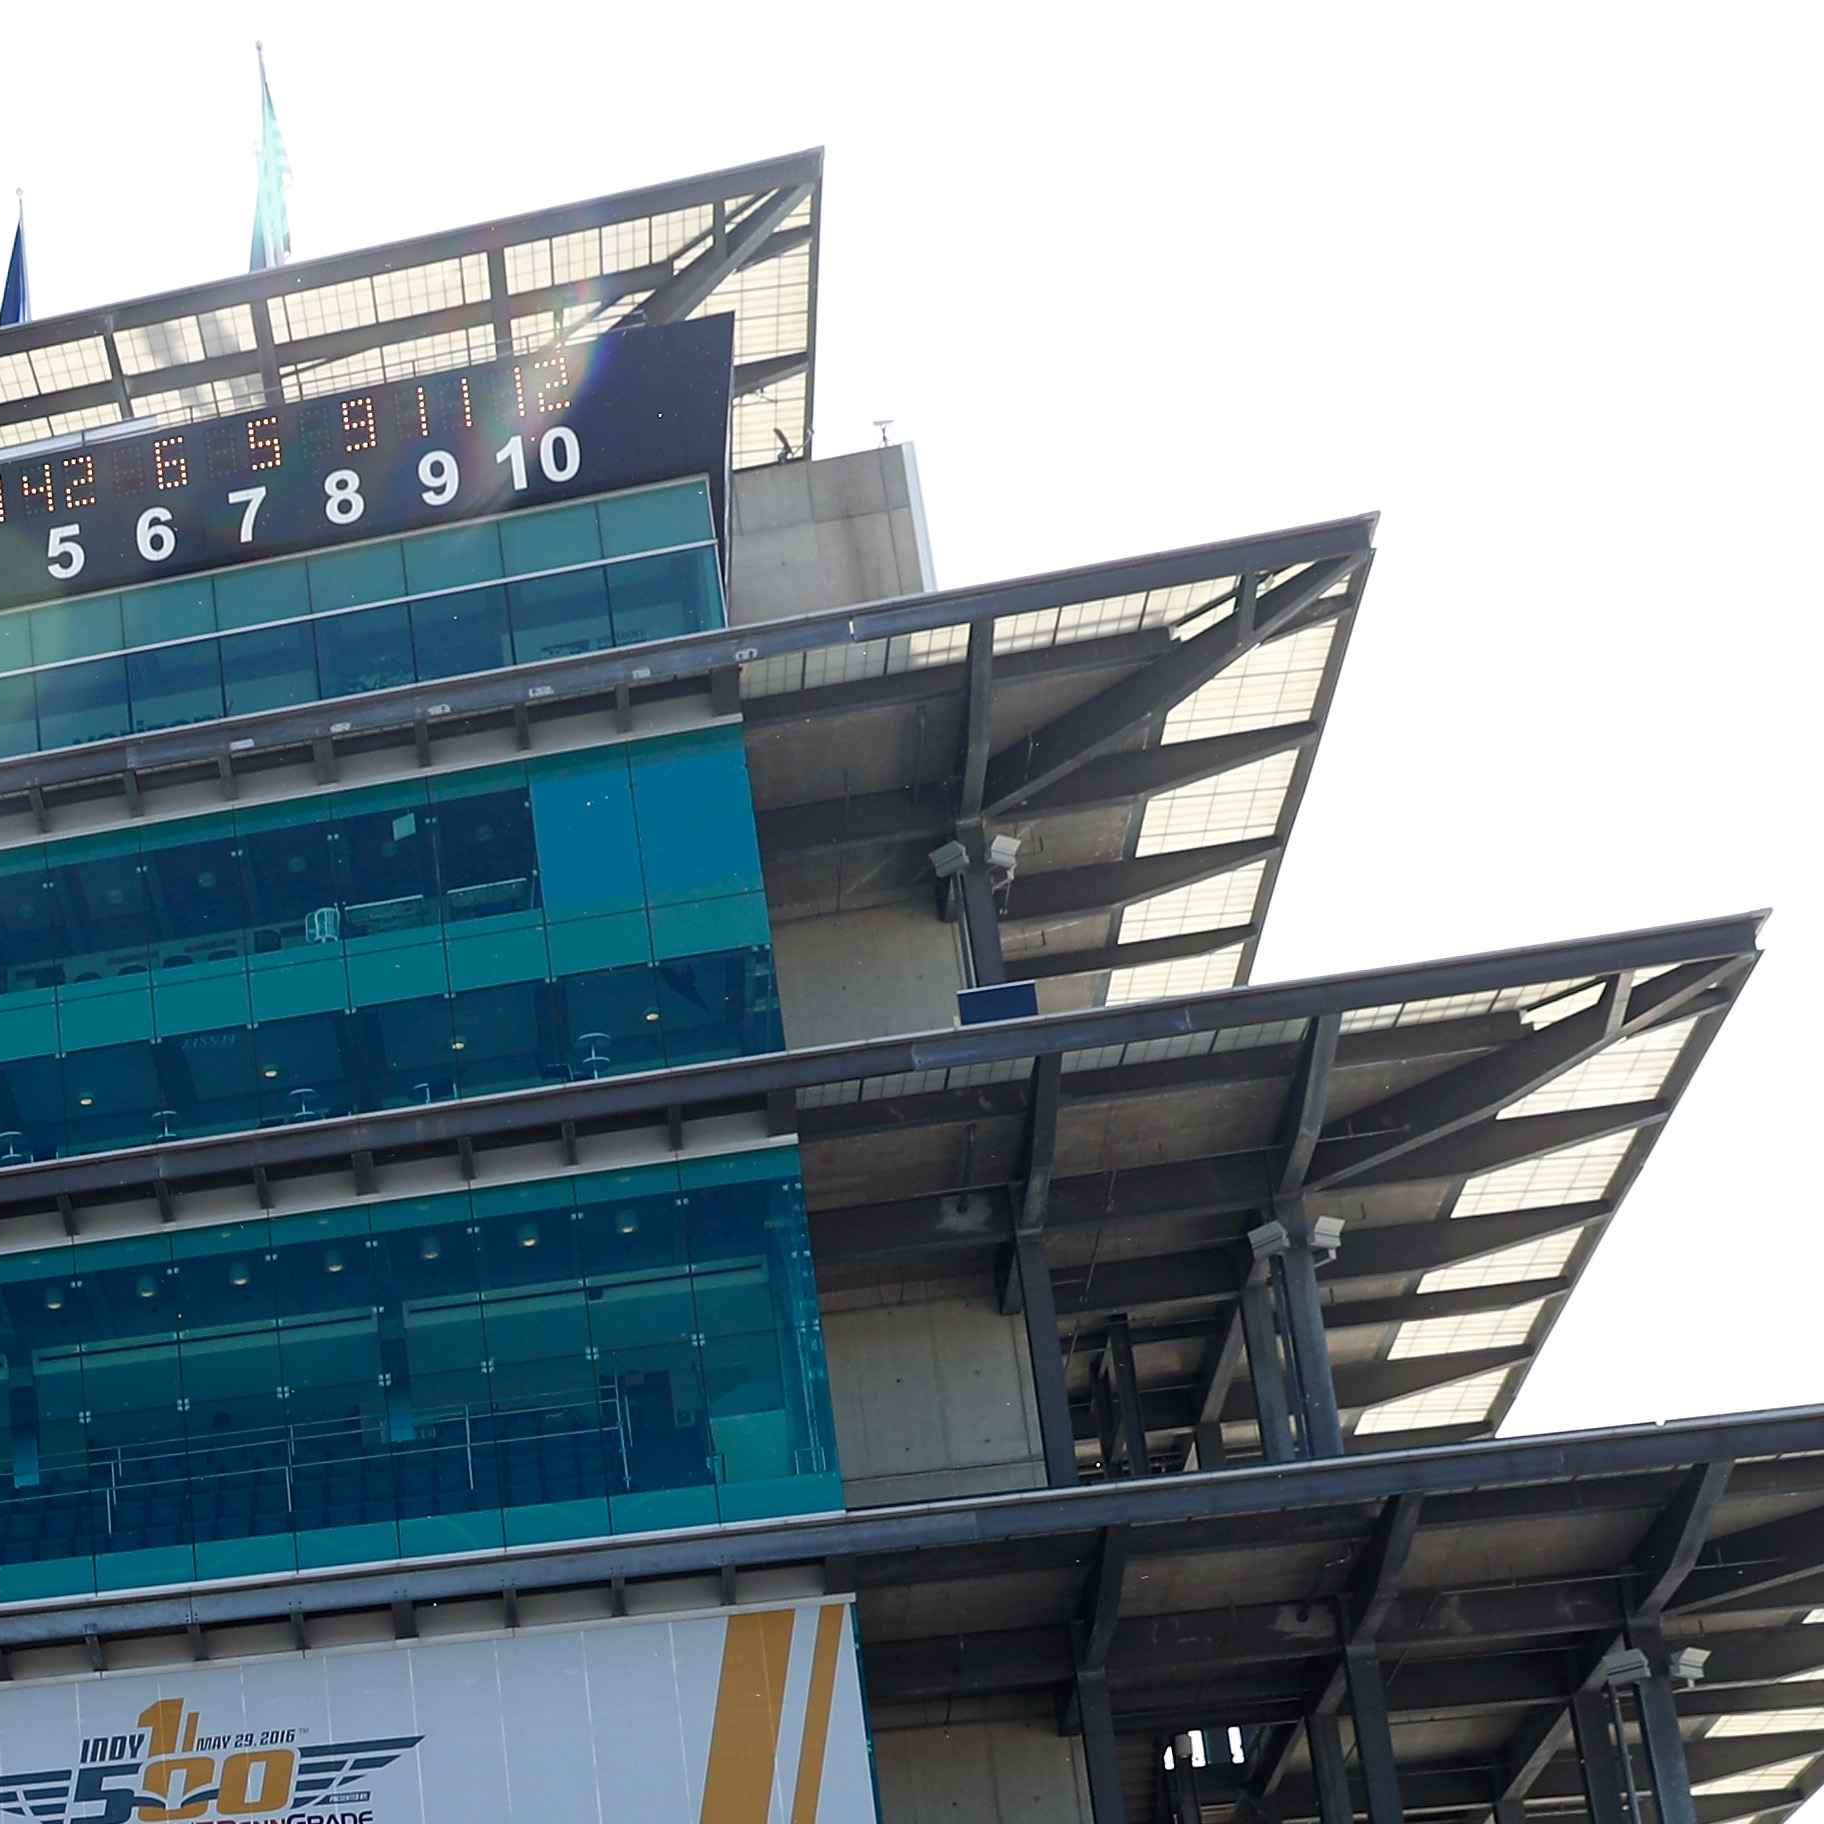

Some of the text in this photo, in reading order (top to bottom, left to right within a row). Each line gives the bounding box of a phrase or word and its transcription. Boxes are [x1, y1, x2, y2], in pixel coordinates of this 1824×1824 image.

[21, 455, 98, 512] 42
[154, 436, 190, 490] 6
[246, 417, 283, 471] 5
[340, 397, 377, 452] 9
[416, 377, 474, 437] 11
[512, 356, 573, 417] 12
[46, 525, 85, 581] 5
[135, 507, 177, 562] 6
[228, 487, 267, 543] 7
[324, 470, 365, 525] 8
[417, 450, 459, 507] 9
[495, 426, 581, 491] 10
[80, 1734, 145, 1764] INDY
[196, 1733, 231, 1752] MAY
[259, 1729, 295, 1746] 2016
